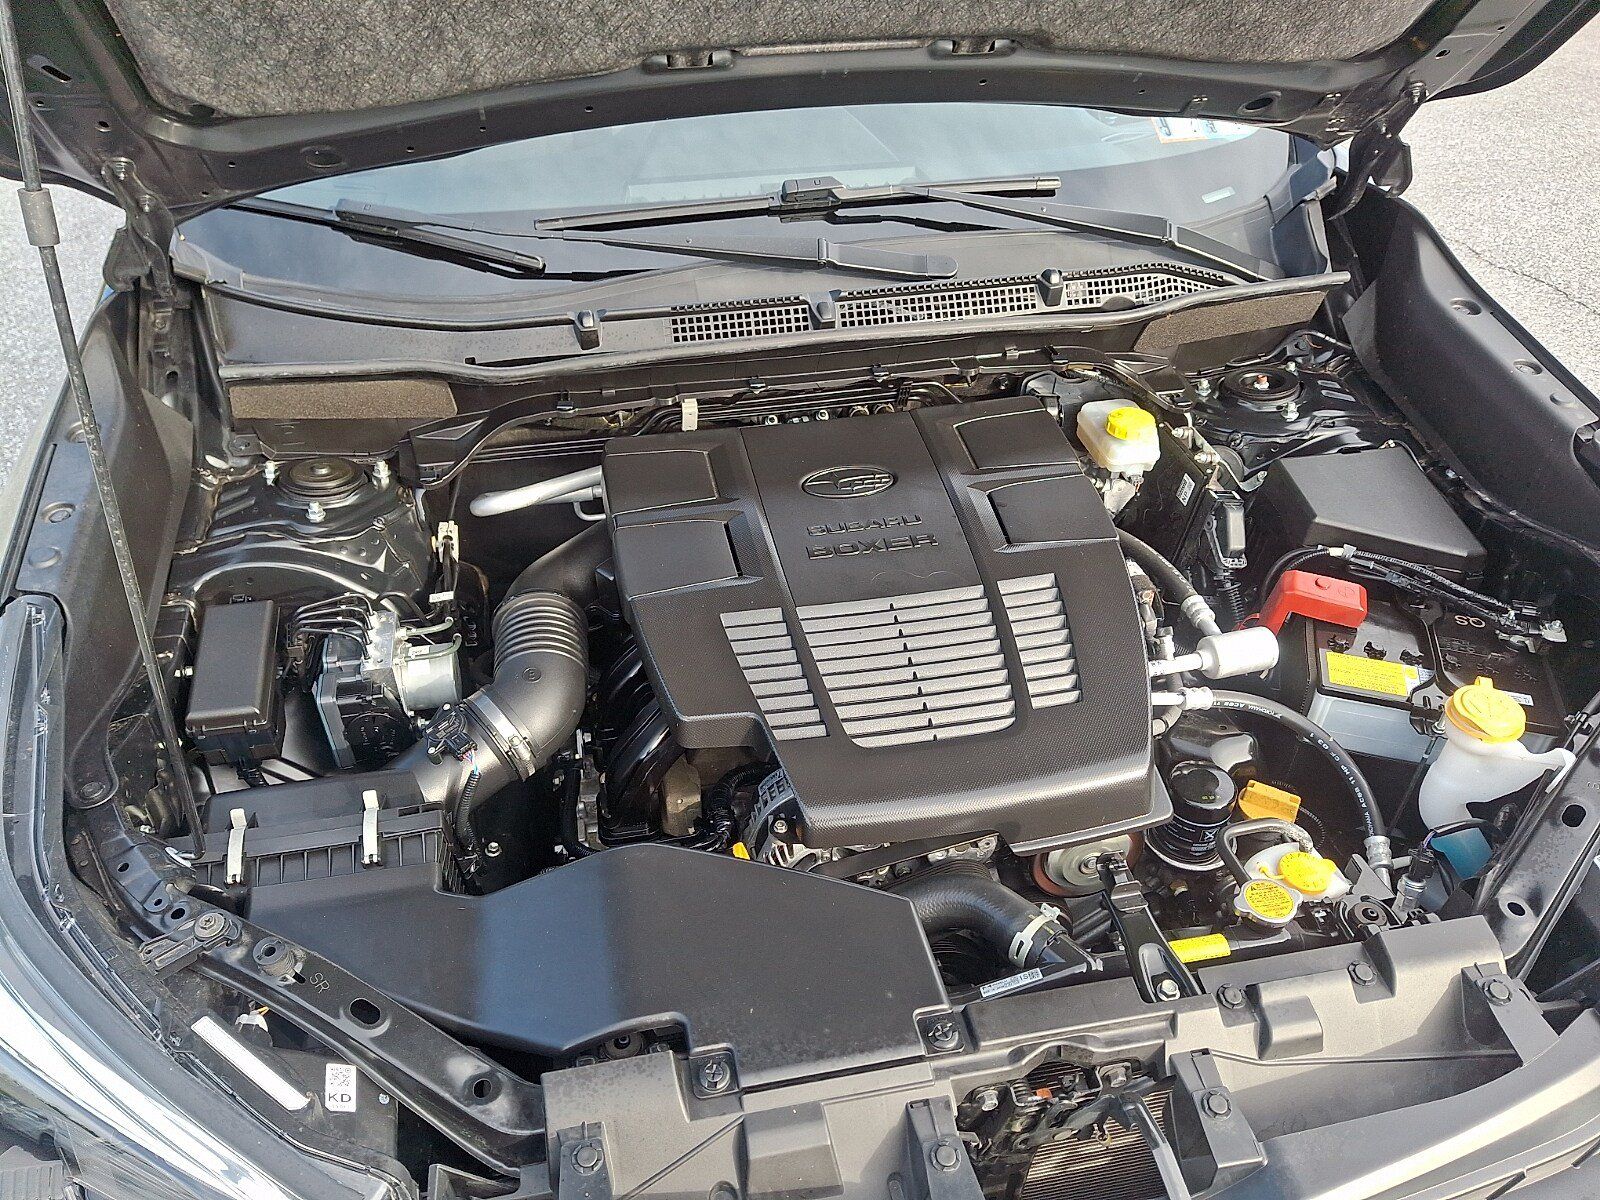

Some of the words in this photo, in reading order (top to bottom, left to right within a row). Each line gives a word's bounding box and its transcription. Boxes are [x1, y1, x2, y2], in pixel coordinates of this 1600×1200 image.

[806, 514, 923, 536] SUBARU
[805, 534, 939, 560] BOXER
[1340, 764, 1350, 775] HP
[309, 972, 331, 994] SR
[328, 1092, 352, 1103] KD
